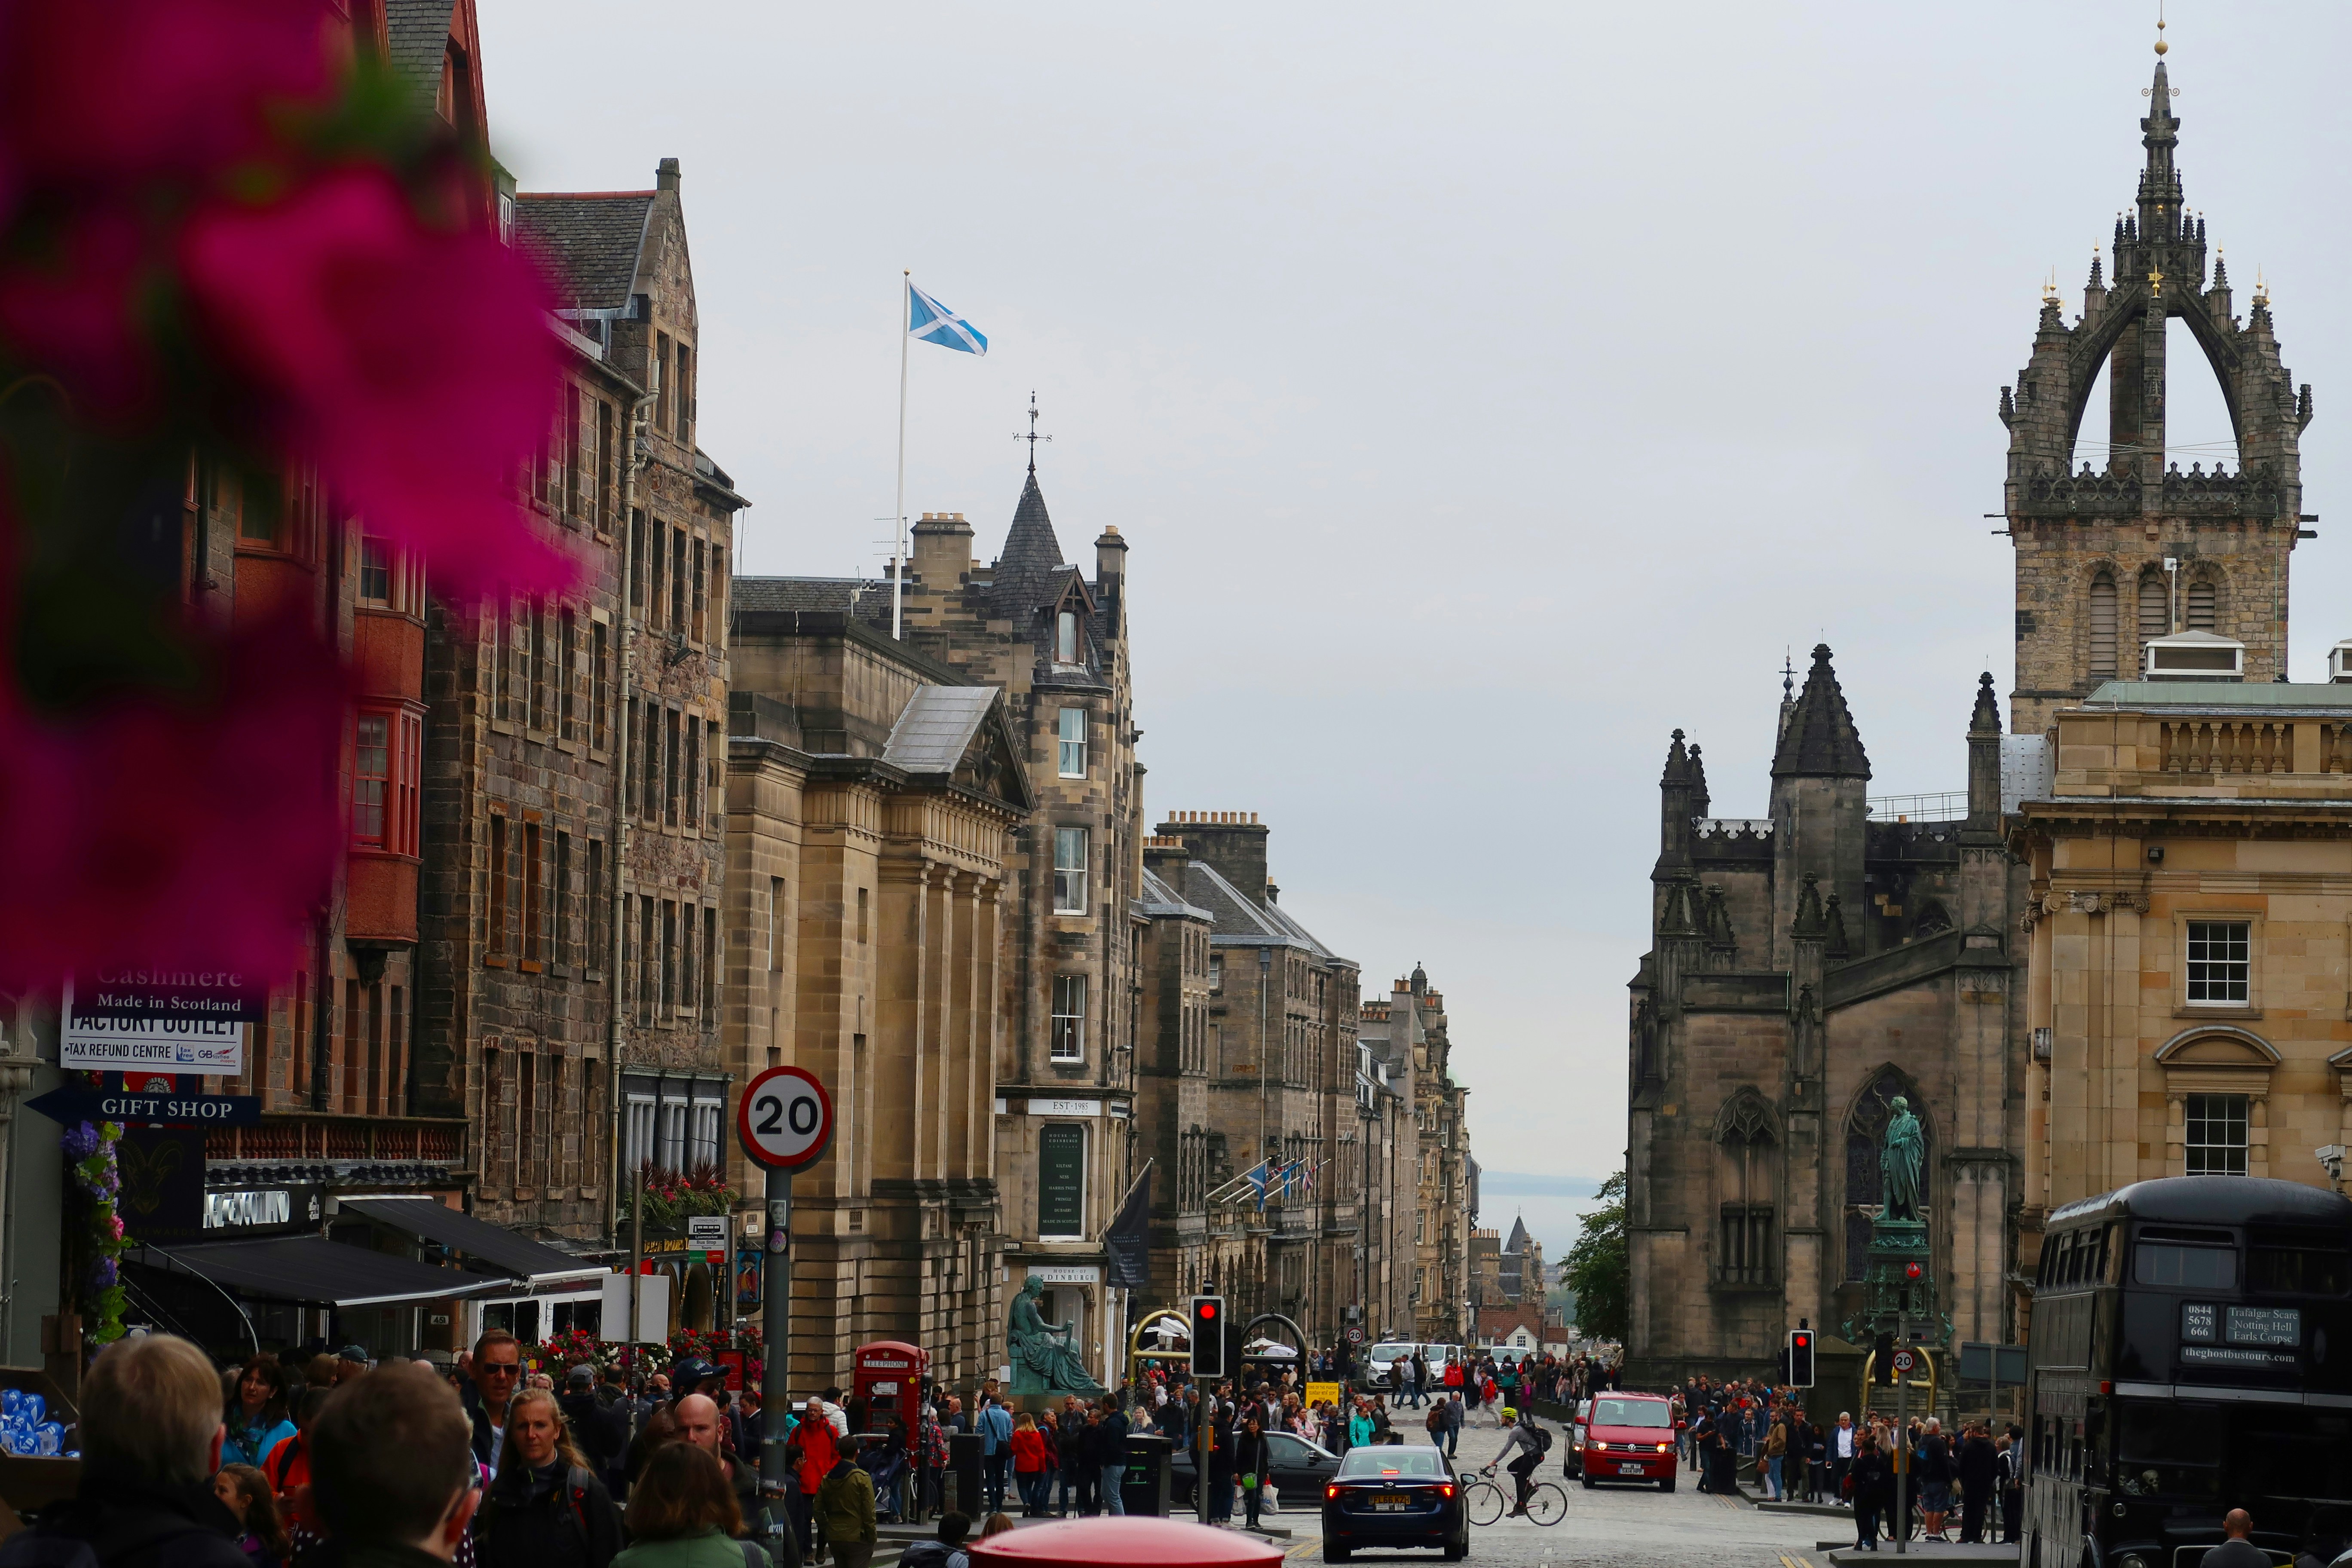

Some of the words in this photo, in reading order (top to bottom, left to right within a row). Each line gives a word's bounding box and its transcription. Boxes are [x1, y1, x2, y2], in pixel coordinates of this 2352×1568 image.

[97, 965, 242, 987] Cashmere
[98, 993, 143, 1008] Made
[149, 995, 164, 1008] in
[171, 996, 241, 1011] Scotland
[68, 1042, 86, 1056] TAX
[89, 1043, 129, 1057] REFUND
[133, 1045, 172, 1058] CENTRE
[102, 1099, 159, 1116] GIFT
[168, 1101, 233, 1118] SHOP
[755, 1095, 818, 1136] 20
[137, 1228, 196, 1236] REWARDS
[2188, 1305, 2212, 1314] 0844
[2230, 1307, 2271, 1320] Trafalgar
[2273, 1310, 2298, 1320] Scare
[2188, 1316, 2212, 1326] 5678
[2235, 1320, 2269, 1332] Notting
[2272, 1322, 2292, 1331] Hell
[2191, 1326, 2208, 1336] 666
[2234, 1331, 2257, 1341] Earls
[2260, 1332, 2293, 1344] Corpse
[1896, 1357, 1911, 1366] 20
[2185, 1348, 2295, 1363] theghostbustours.com
